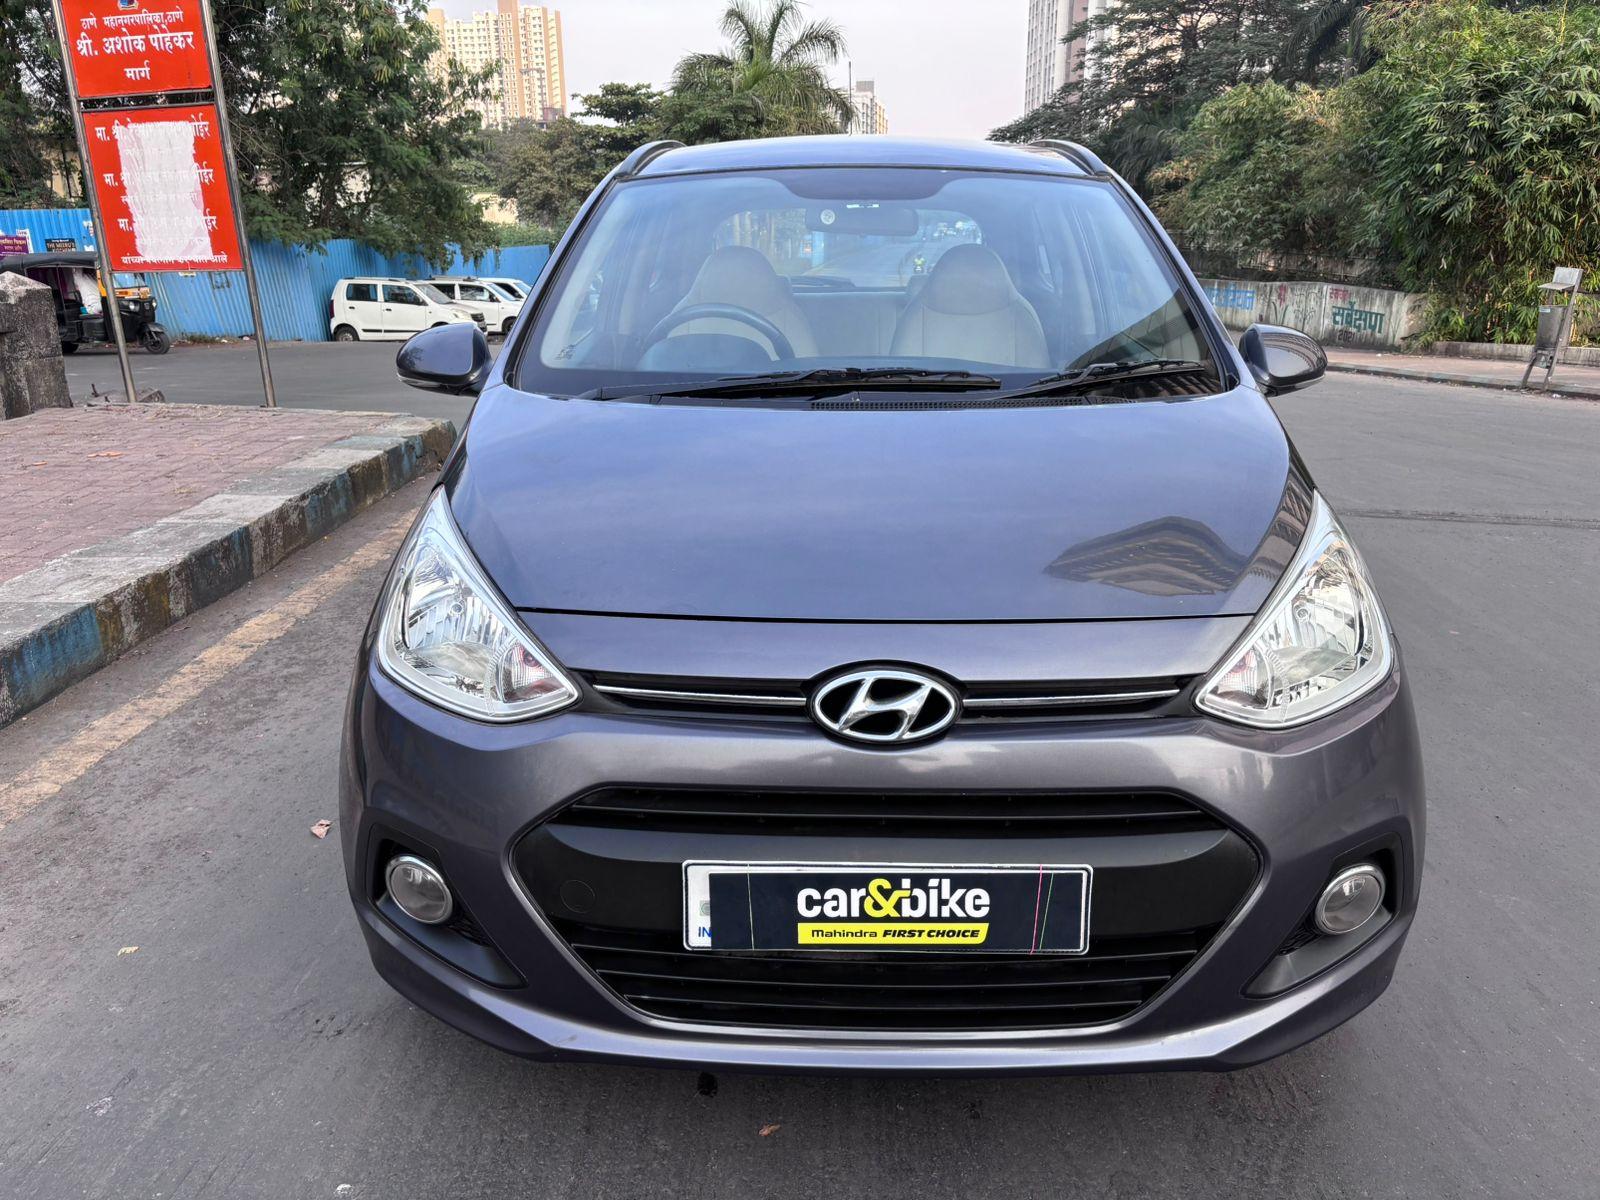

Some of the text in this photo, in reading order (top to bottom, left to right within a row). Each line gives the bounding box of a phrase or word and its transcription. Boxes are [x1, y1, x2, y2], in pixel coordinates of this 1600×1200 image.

[80, 12, 98, 30] ठाणे
[76, 23, 196, 57] श्री. अशोक पोहेकर
[124, 60, 151, 81] मार्ग
[95, 126, 110, 141] मा.
[103, 173, 119, 187] मा.
[117, 218, 133, 232] मा.
[698, 926, 712, 938] IN
